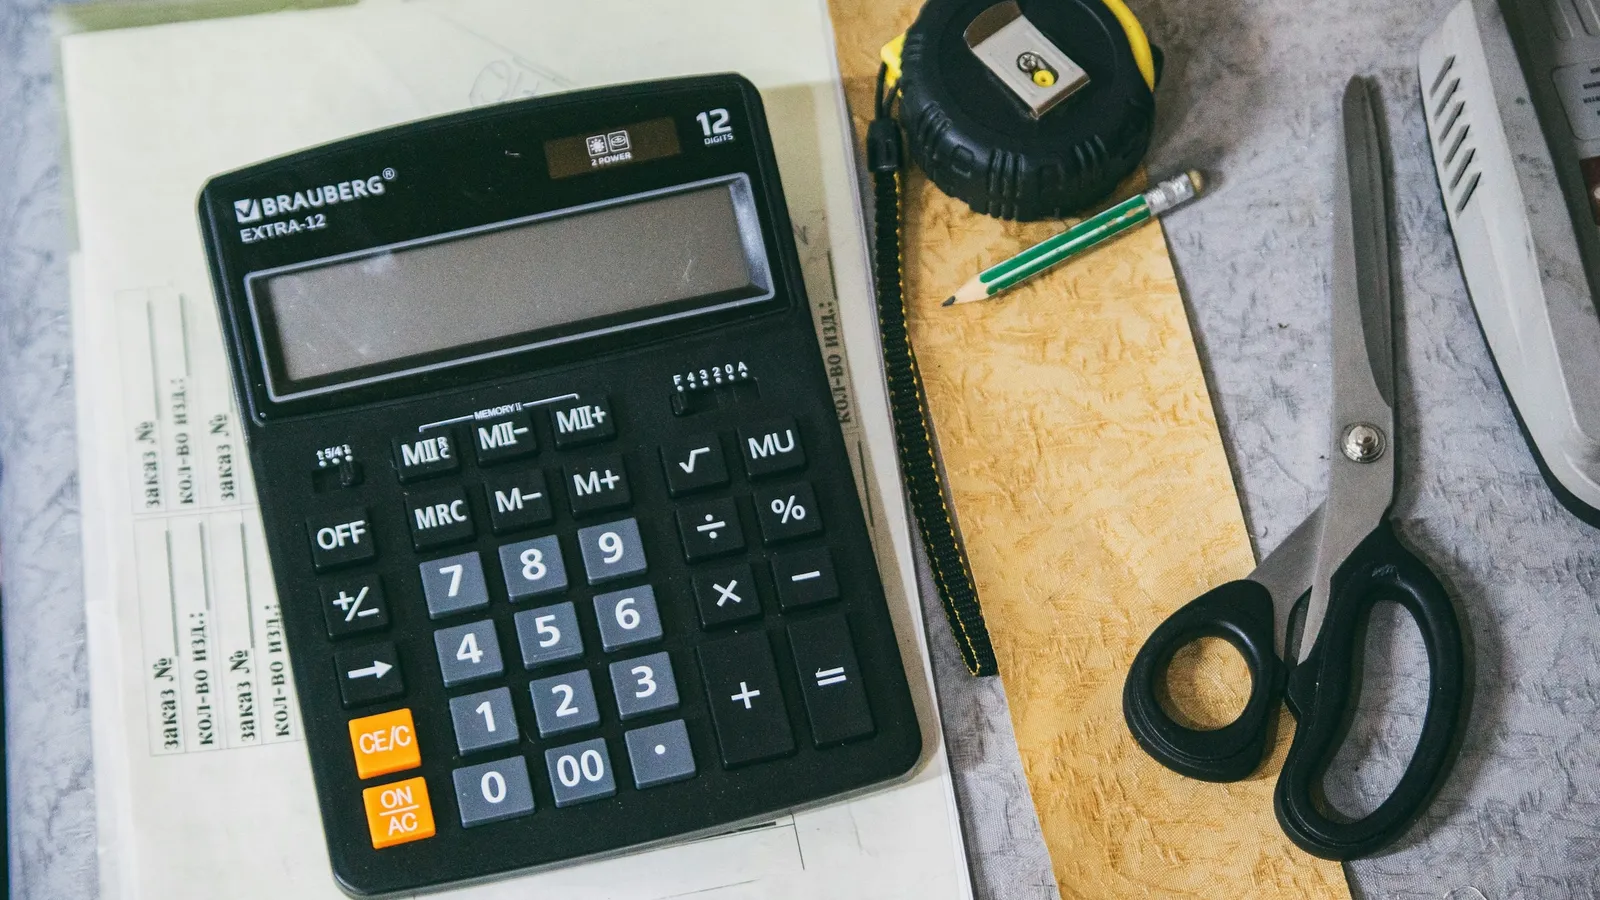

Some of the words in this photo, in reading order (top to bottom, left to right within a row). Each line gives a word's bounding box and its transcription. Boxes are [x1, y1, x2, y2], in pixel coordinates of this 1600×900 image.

[696, 108, 732, 137] 12
[704, 132, 734, 145] DIGITS
[591, 158, 598, 167] 2
[598, 152, 633, 165] POWER
[239, 213, 327, 244] EXTRA-12
[673, 374, 682, 385] F
[687, 371, 695, 382] 4
[699, 369, 708, 380] 3
[712, 366, 721, 377] 2
[725, 363, 734, 374] 0
[738, 361, 748, 372] A
[474, 403, 515, 420] MEMORY
[747, 429, 796, 460] MU
[216, 443, 235, 500] заказ
[573, 468, 620, 496] M+
[414, 499, 468, 531] MRC
[770, 495, 806, 524] %
[316, 519, 366, 550] OFF
[598, 531, 624, 565] 9
[519, 548, 548, 581] 8
[439, 564, 464, 598] 7
[614, 597, 641, 630] 6
[534, 614, 561, 648] 5
[229, 650, 250, 674] №
[455, 632, 483, 664] 4
[153, 657, 174, 682] №
[630, 665, 657, 699] 3
[193, 669, 214, 746] кол-во
[236, 681, 256, 742] заказ
[269, 661, 290, 737] кол-во
[551, 684, 579, 717] 2
[160, 688, 179, 749] заказ
[475, 701, 497, 733] 1
[358, 725, 412, 755] CE/C
[556, 749, 605, 788] 00
[380, 786, 413, 809] ON
[480, 771, 508, 804] 0
[387, 813, 419, 836] AC
